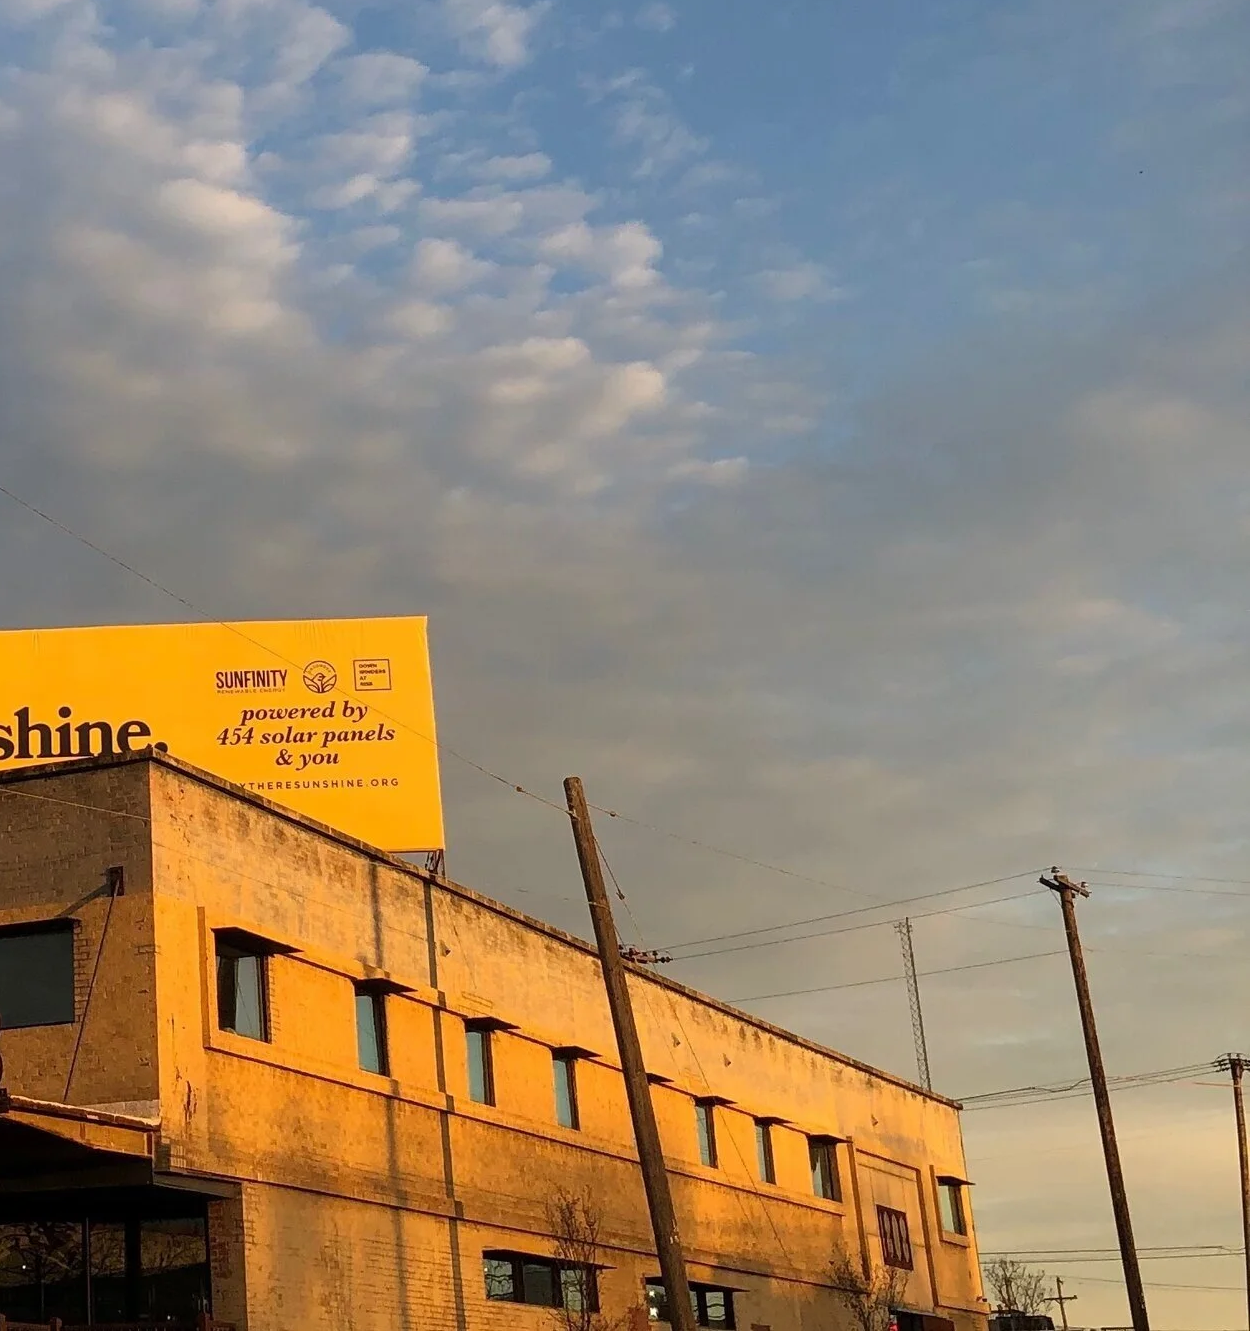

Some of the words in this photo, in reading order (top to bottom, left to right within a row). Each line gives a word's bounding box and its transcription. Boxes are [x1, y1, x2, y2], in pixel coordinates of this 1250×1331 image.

[215, 669, 288, 689] SUNFINITY
[239, 700, 336, 727] powered
[342, 700, 368, 723] by
[216, 727, 255, 746] 454
[259, 725, 318, 745] solar
[320, 723, 396, 749] panels
[275, 748, 294, 767] &
[295, 752, 340, 771] you
[239, 778, 399, 790] YTHERESUNSHINE.ORG
